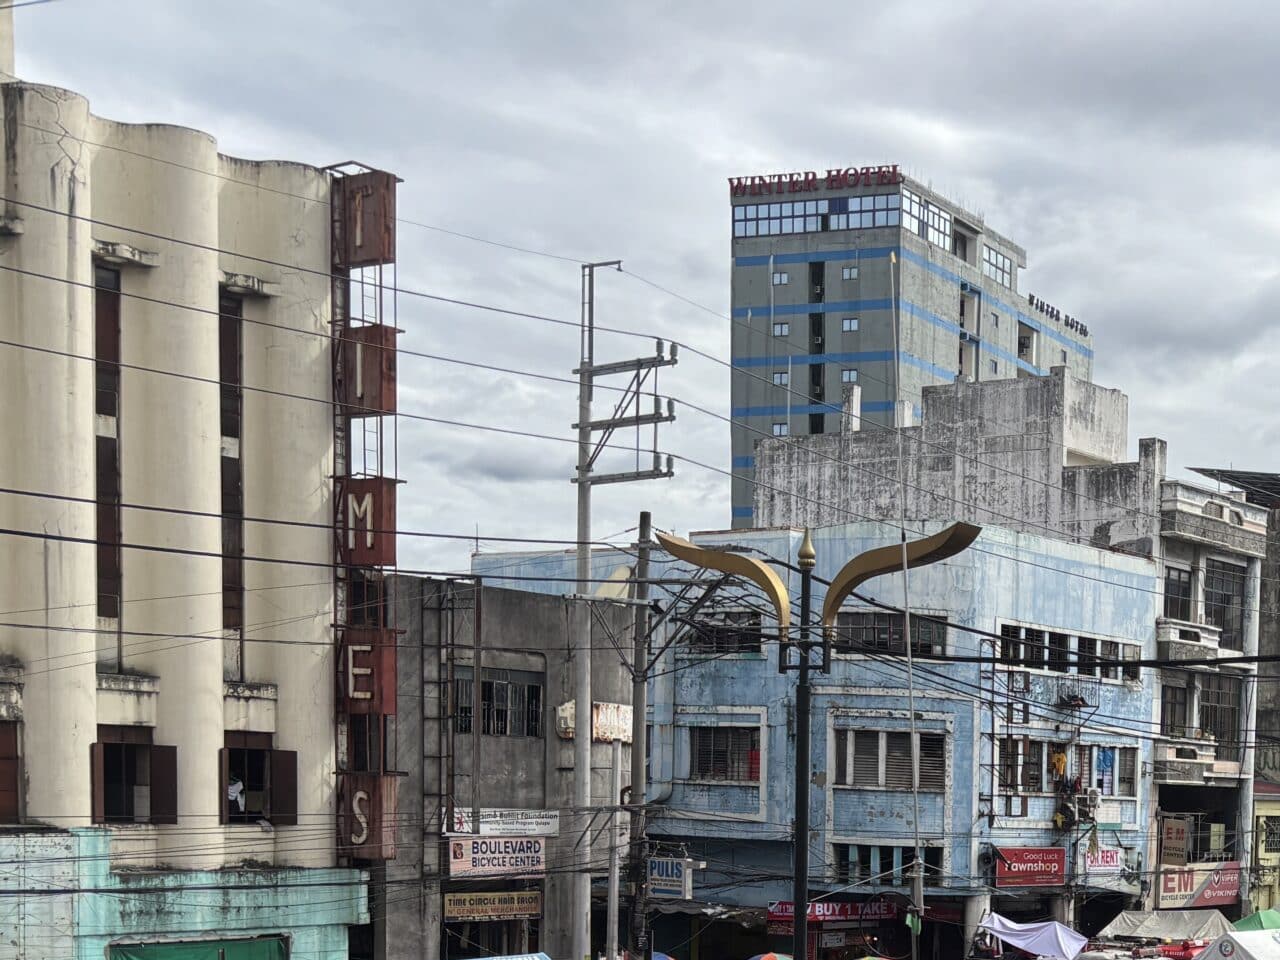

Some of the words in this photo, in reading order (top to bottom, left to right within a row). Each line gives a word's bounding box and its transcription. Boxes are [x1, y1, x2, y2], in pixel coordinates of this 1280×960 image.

[728, 171, 818, 197] WINTER
[825, 164, 905, 190] HOTEL
[1028, 292, 1060, 321] WINTER
[1064, 314, 1089, 338] HOTEL
[472, 840, 542, 855] BOULEVARD
[472, 857, 507, 868] BICYCLE
[508, 856, 541, 867] CENTER
[1023, 852, 1043, 860] Good
[1043, 852, 1058, 860] Luck
[1086, 851, 1099, 865] FOR
[1101, 849, 1119, 865] RENT
[650, 860, 683, 879] PULIS
[1162, 868, 1195, 894] EM
[815, 902, 841, 915] BUY
[846, 902, 852, 915] 1
[856, 902, 888, 915] TAKE
